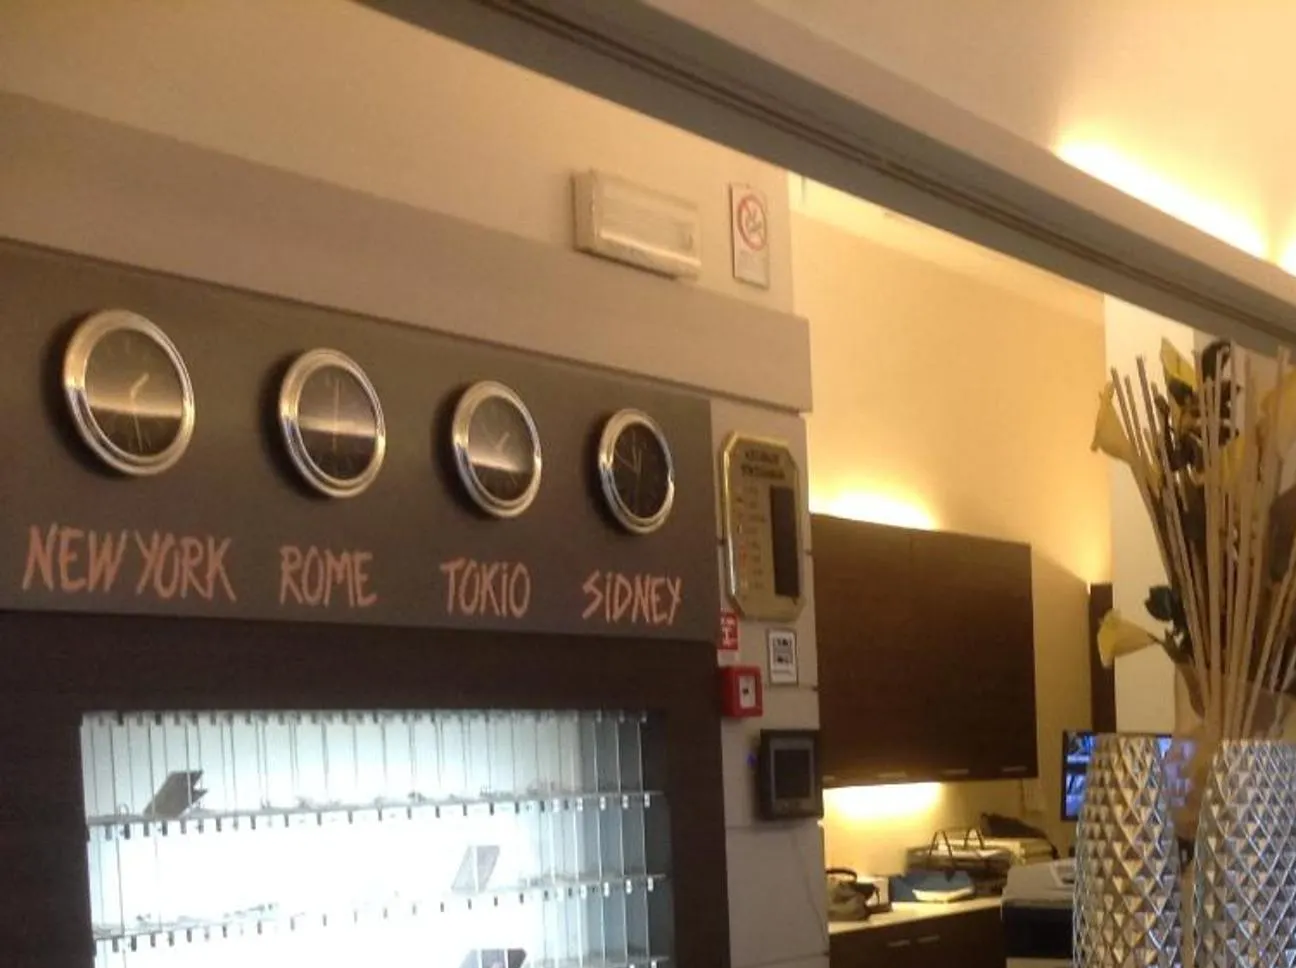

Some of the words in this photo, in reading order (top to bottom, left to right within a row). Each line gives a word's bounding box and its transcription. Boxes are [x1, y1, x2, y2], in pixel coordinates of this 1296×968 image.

[23, 522, 128, 592] NEW
[134, 530, 237, 601] YORK
[280, 546, 377, 608] ROME
[582, 570, 681, 625] SIDNEY
